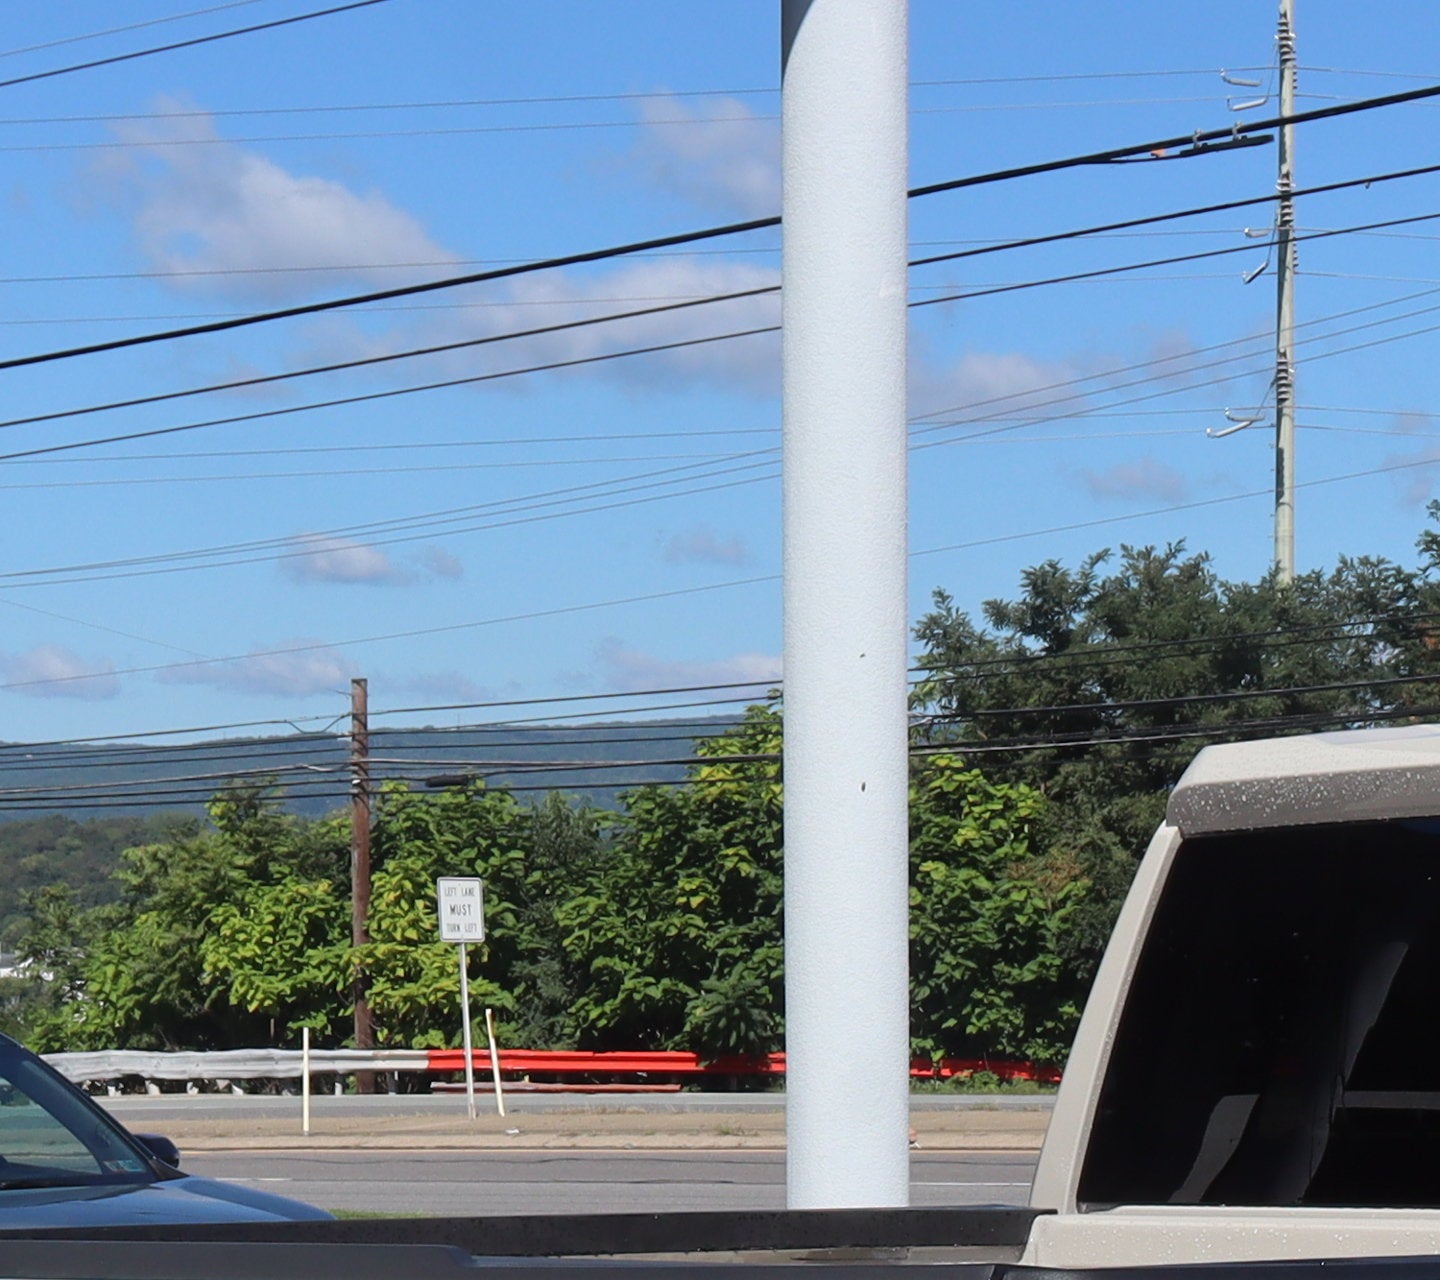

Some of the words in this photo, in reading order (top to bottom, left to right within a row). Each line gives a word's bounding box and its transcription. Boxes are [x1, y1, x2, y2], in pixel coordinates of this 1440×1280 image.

[444, 887, 457, 897] LEFT
[462, 887, 475, 897] LANE
[449, 903, 472, 916] MUST
[447, 923, 460, 932] TURN
[465, 923, 477, 933] LEFT
